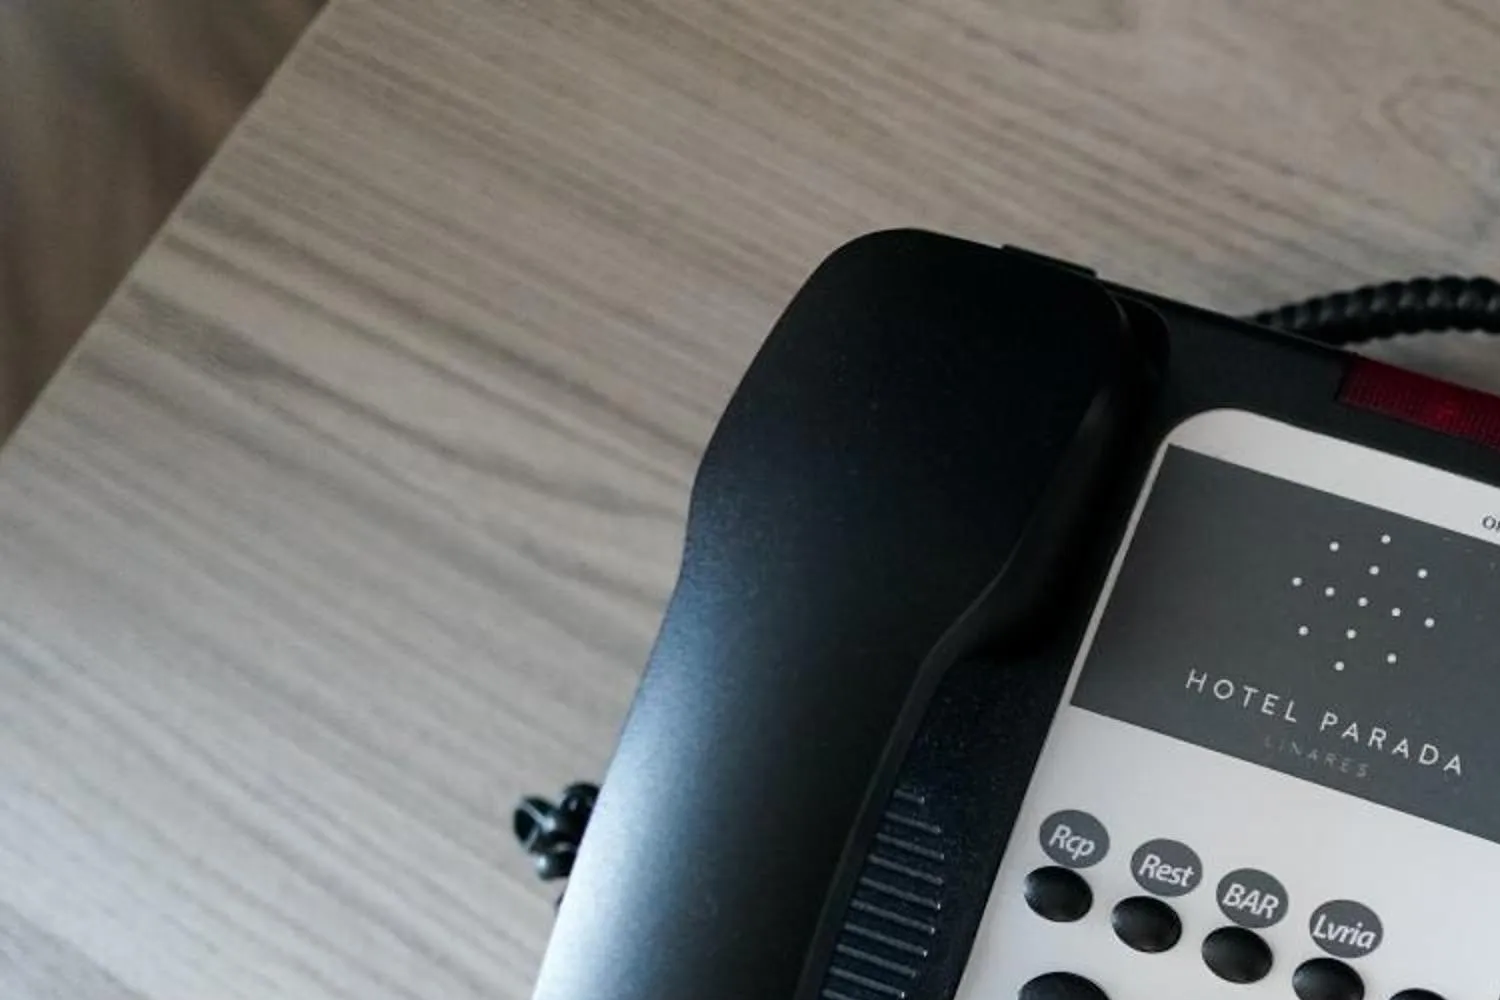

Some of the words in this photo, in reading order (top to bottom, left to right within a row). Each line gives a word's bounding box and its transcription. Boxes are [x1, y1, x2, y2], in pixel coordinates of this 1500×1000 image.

[1185, 669, 1298, 723] HOTEL
[1319, 711, 1463, 776] PARADA
[1264, 736, 1370, 779] LINARES
[1048, 825, 1097, 859] Rcp
[1138, 853, 1195, 888] Rest
[1222, 883, 1280, 919] BAR
[1313, 914, 1377, 950] Lvria
